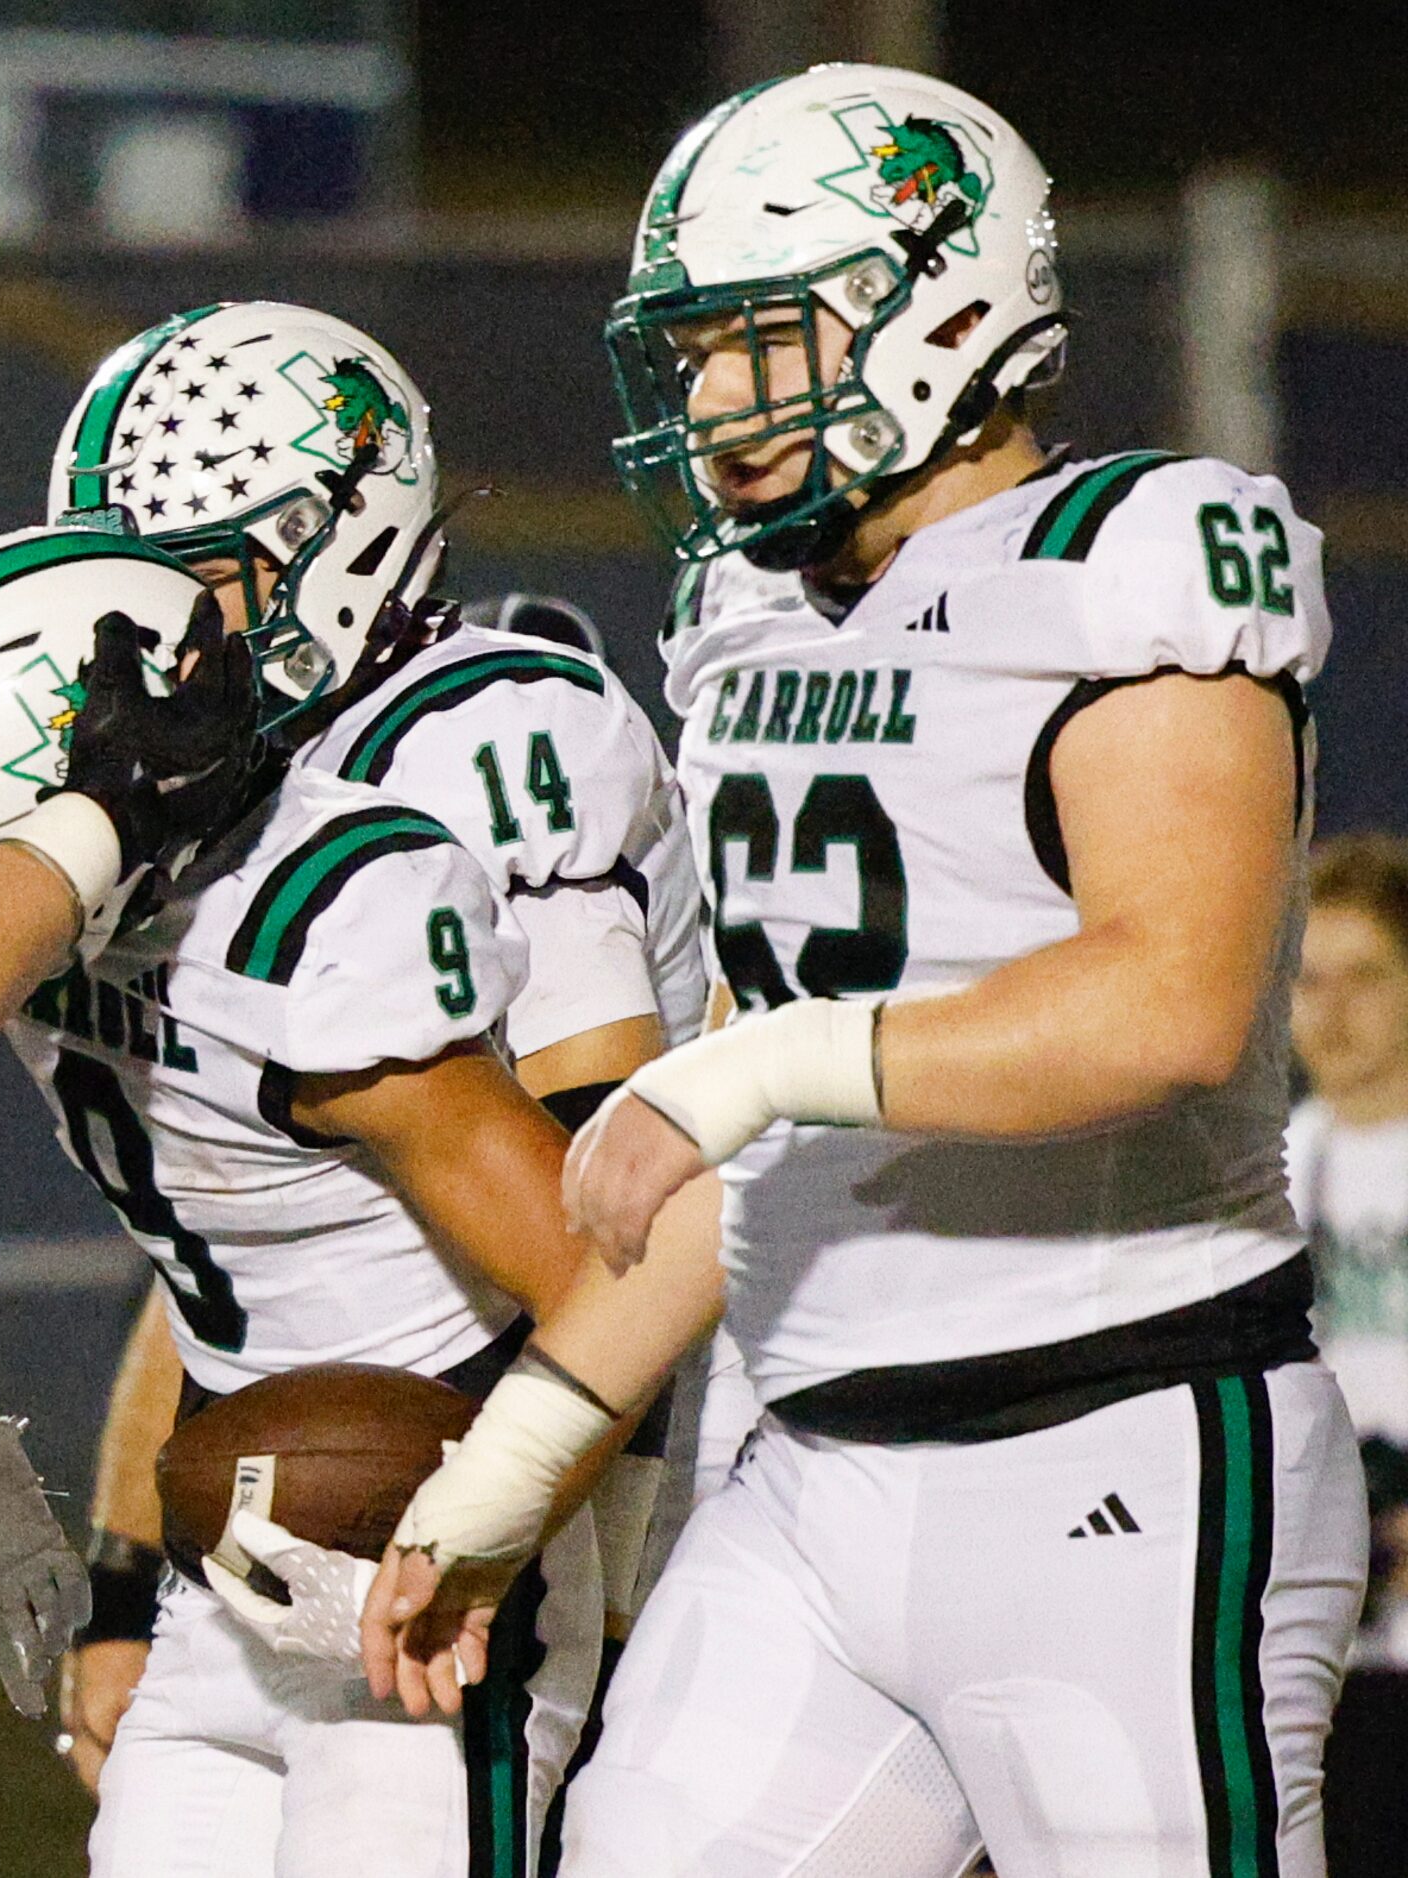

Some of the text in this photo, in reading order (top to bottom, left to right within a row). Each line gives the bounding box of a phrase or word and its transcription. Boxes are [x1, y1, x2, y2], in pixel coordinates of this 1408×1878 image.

[1194, 502, 1295, 619] 62
[707, 668, 917, 745] CARROLL
[471, 729, 575, 848] 14
[425, 905, 478, 1020] 9
